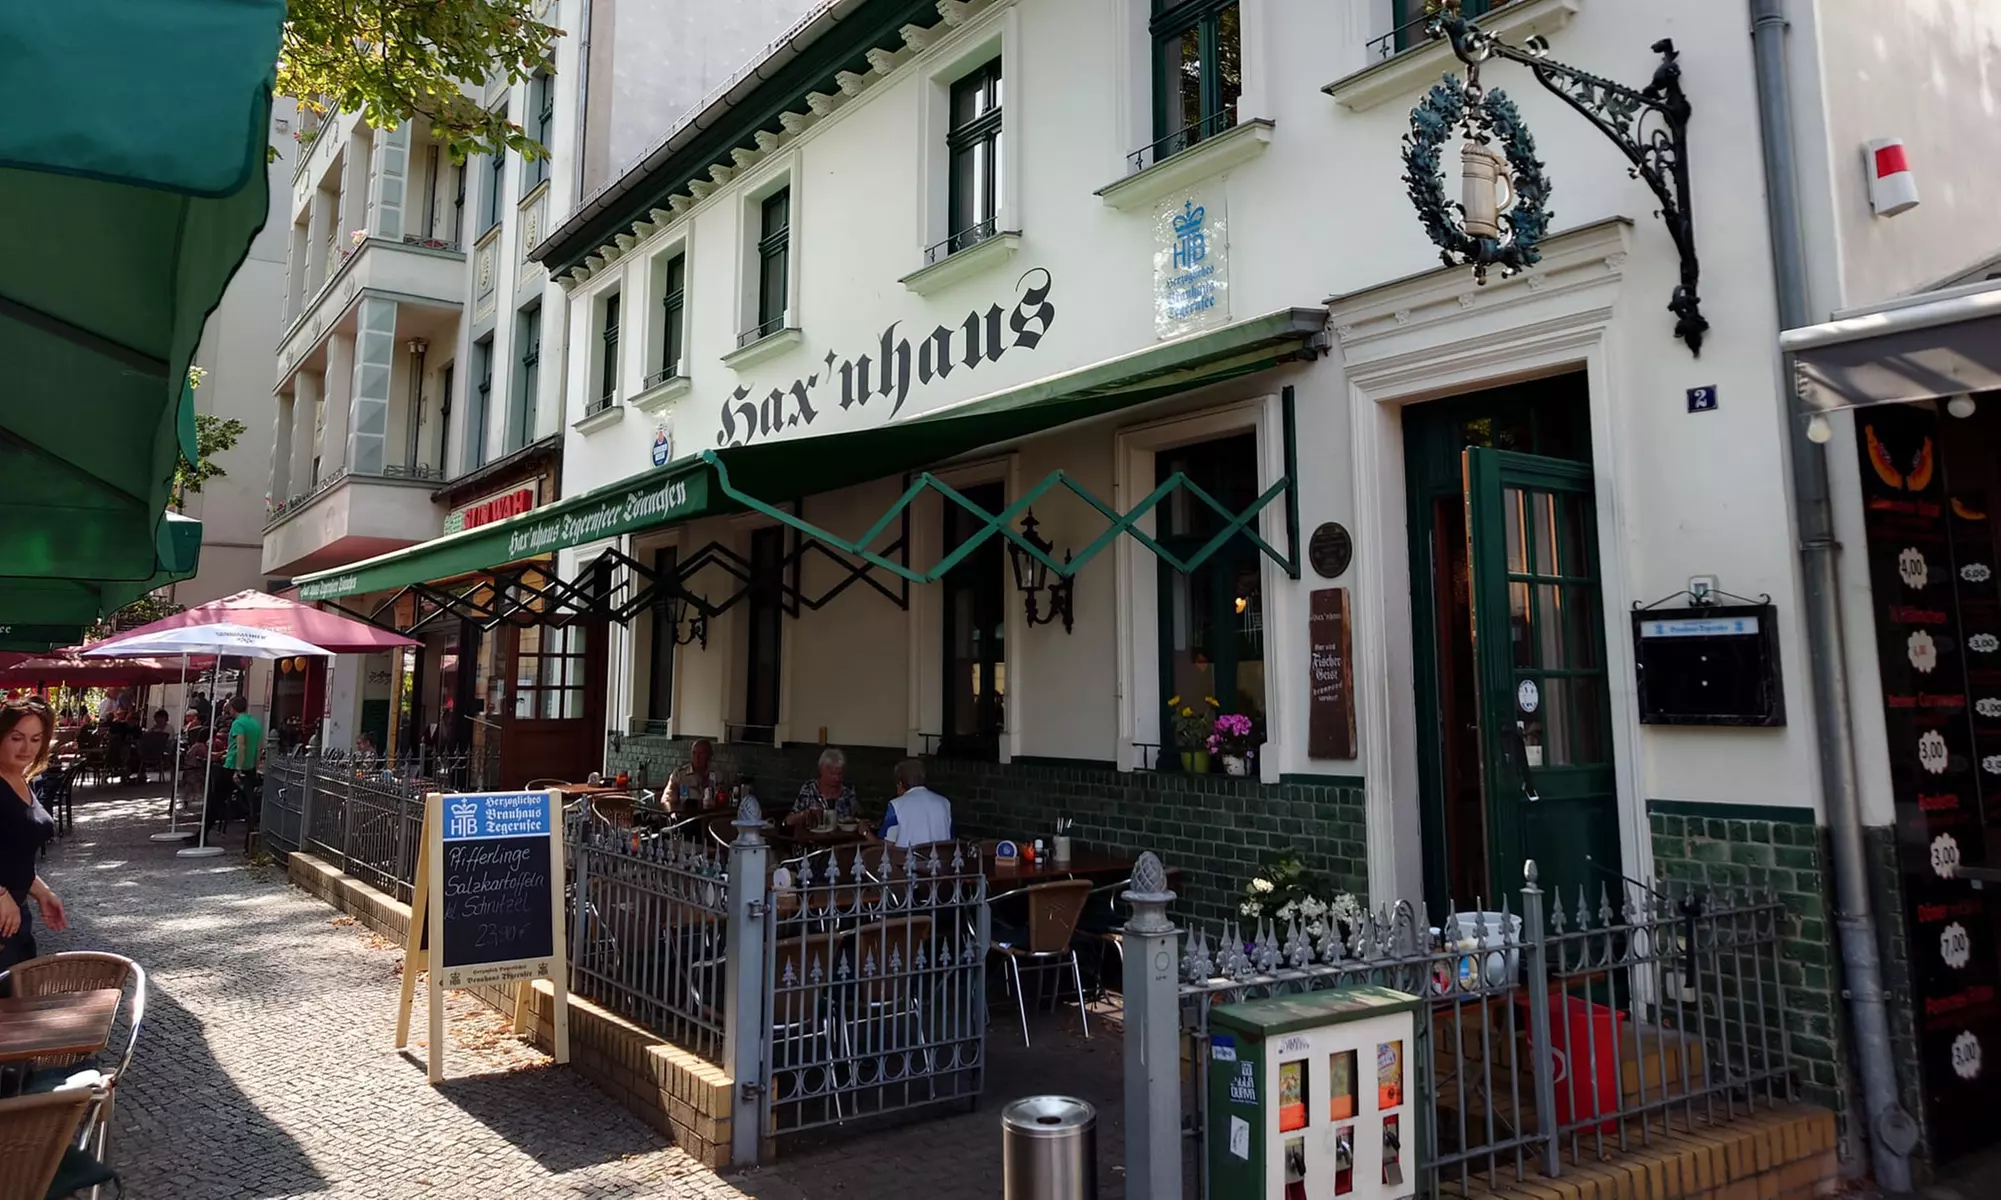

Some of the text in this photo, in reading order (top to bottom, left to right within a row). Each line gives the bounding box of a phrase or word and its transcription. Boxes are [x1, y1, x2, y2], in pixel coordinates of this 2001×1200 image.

[717, 267, 1055, 448] Hax'nhaus
[1694, 389, 1707, 408] 2
[492, 488, 534, 521] WAH
[508, 517, 560, 560] Hax'nhaus
[561, 505, 623, 545] Tegernseer
[1921, 741, 1943, 762] 3,00
[484, 796, 541, 807] Herzogliches
[485, 808, 542, 821] Brauhaus
[485, 820, 541, 834] Tegernsee
[449, 844, 531, 872] Pfifferlinge
[445, 871, 544, 898] Salzkartoffeln
[462, 892, 532, 918] Schnitzel
